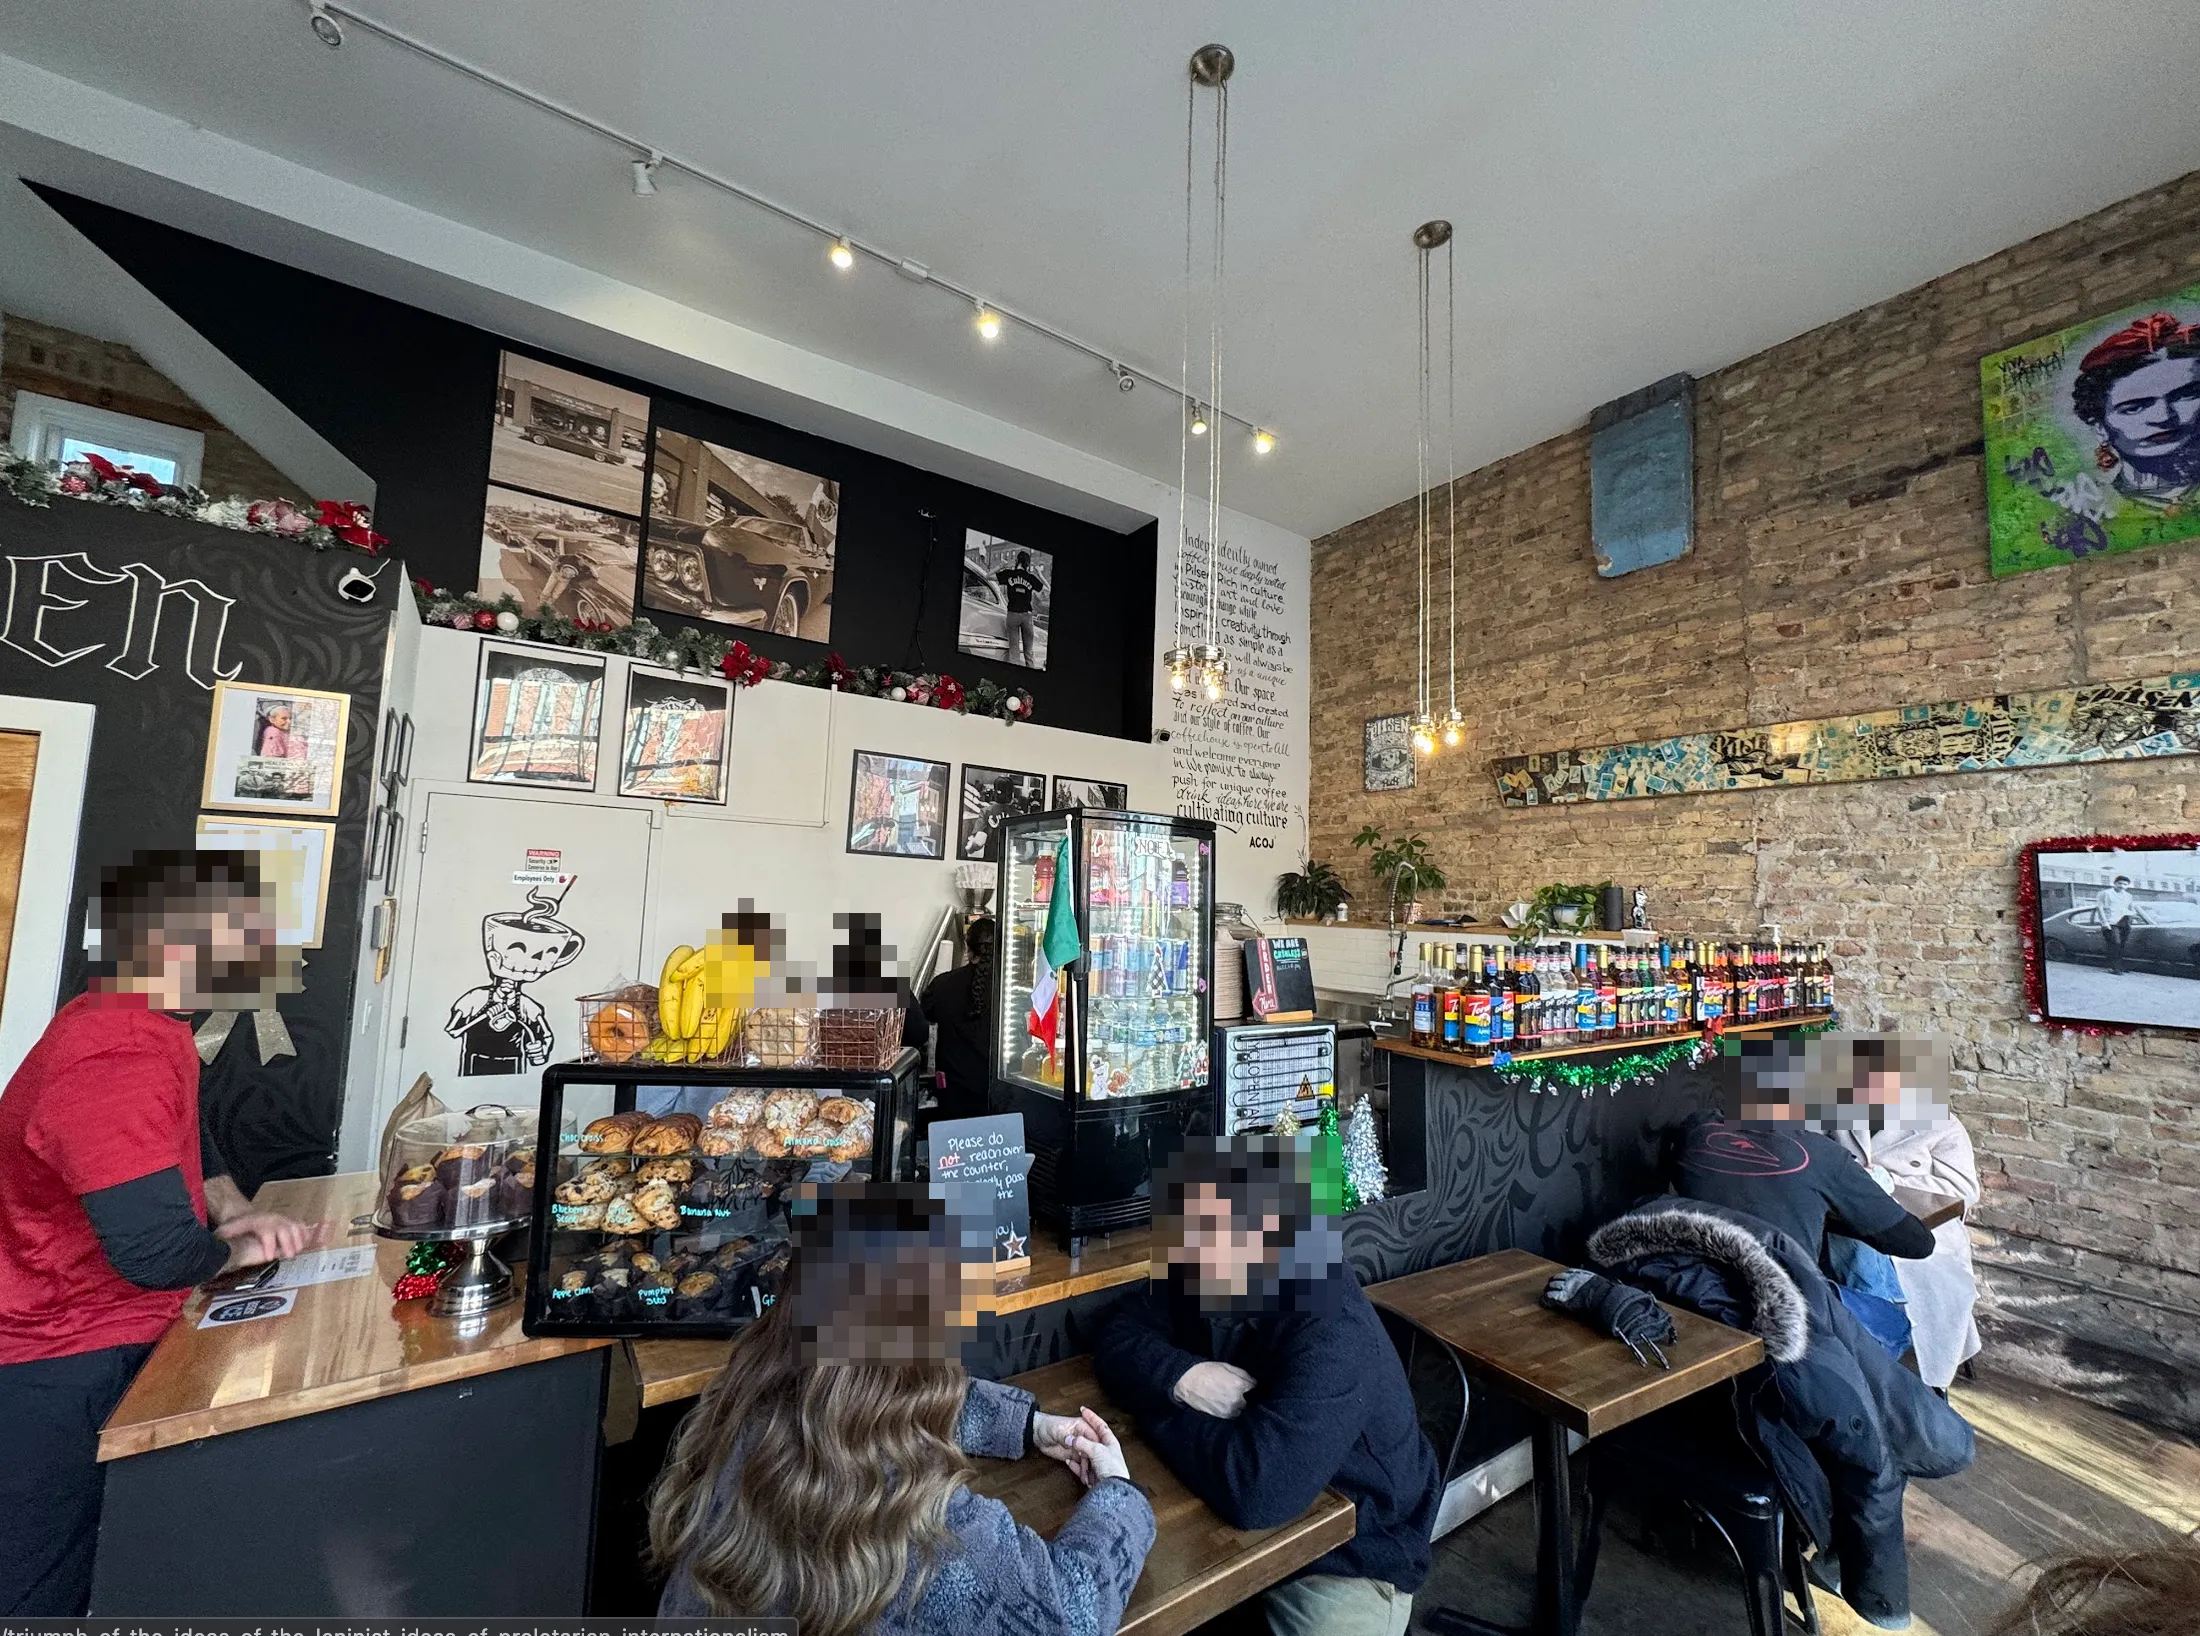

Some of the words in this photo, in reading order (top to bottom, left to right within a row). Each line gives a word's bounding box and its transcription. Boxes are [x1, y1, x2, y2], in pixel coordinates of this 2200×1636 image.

[1250, 586, 1285, 604] culture
[1223, 633, 1235, 645] as
[1234, 652, 1251, 664] will
[1252, 687, 1276, 702] space
[1173, 743, 1193, 757] and
[1238, 756, 1281, 771] everyone
[1171, 773, 1198, 789] push
[1202, 776, 1217, 790] for
[1220, 782, 1254, 796] unique
[1256, 786, 1287, 799] coffee
[1176, 801, 1244, 825] cultivating
[1246, 811, 1288, 829] culture
[543, 875, 555, 883] Only
[1272, 939, 1285, 949] WE
[1285, 938, 1299, 948] ARE
[948, 1134, 984, 1151] Please
[988, 1131, 1004, 1146] do
[939, 1153, 962, 1168] not
[969, 1147, 1001, 1162] reach
[1002, 1145, 1024, 1157] over
[941, 1168, 959, 1180] the
[1005, 1173, 1025, 1188] pass
[997, 1188, 1014, 1200] the
[680, 1205, 712, 1217] Banana
